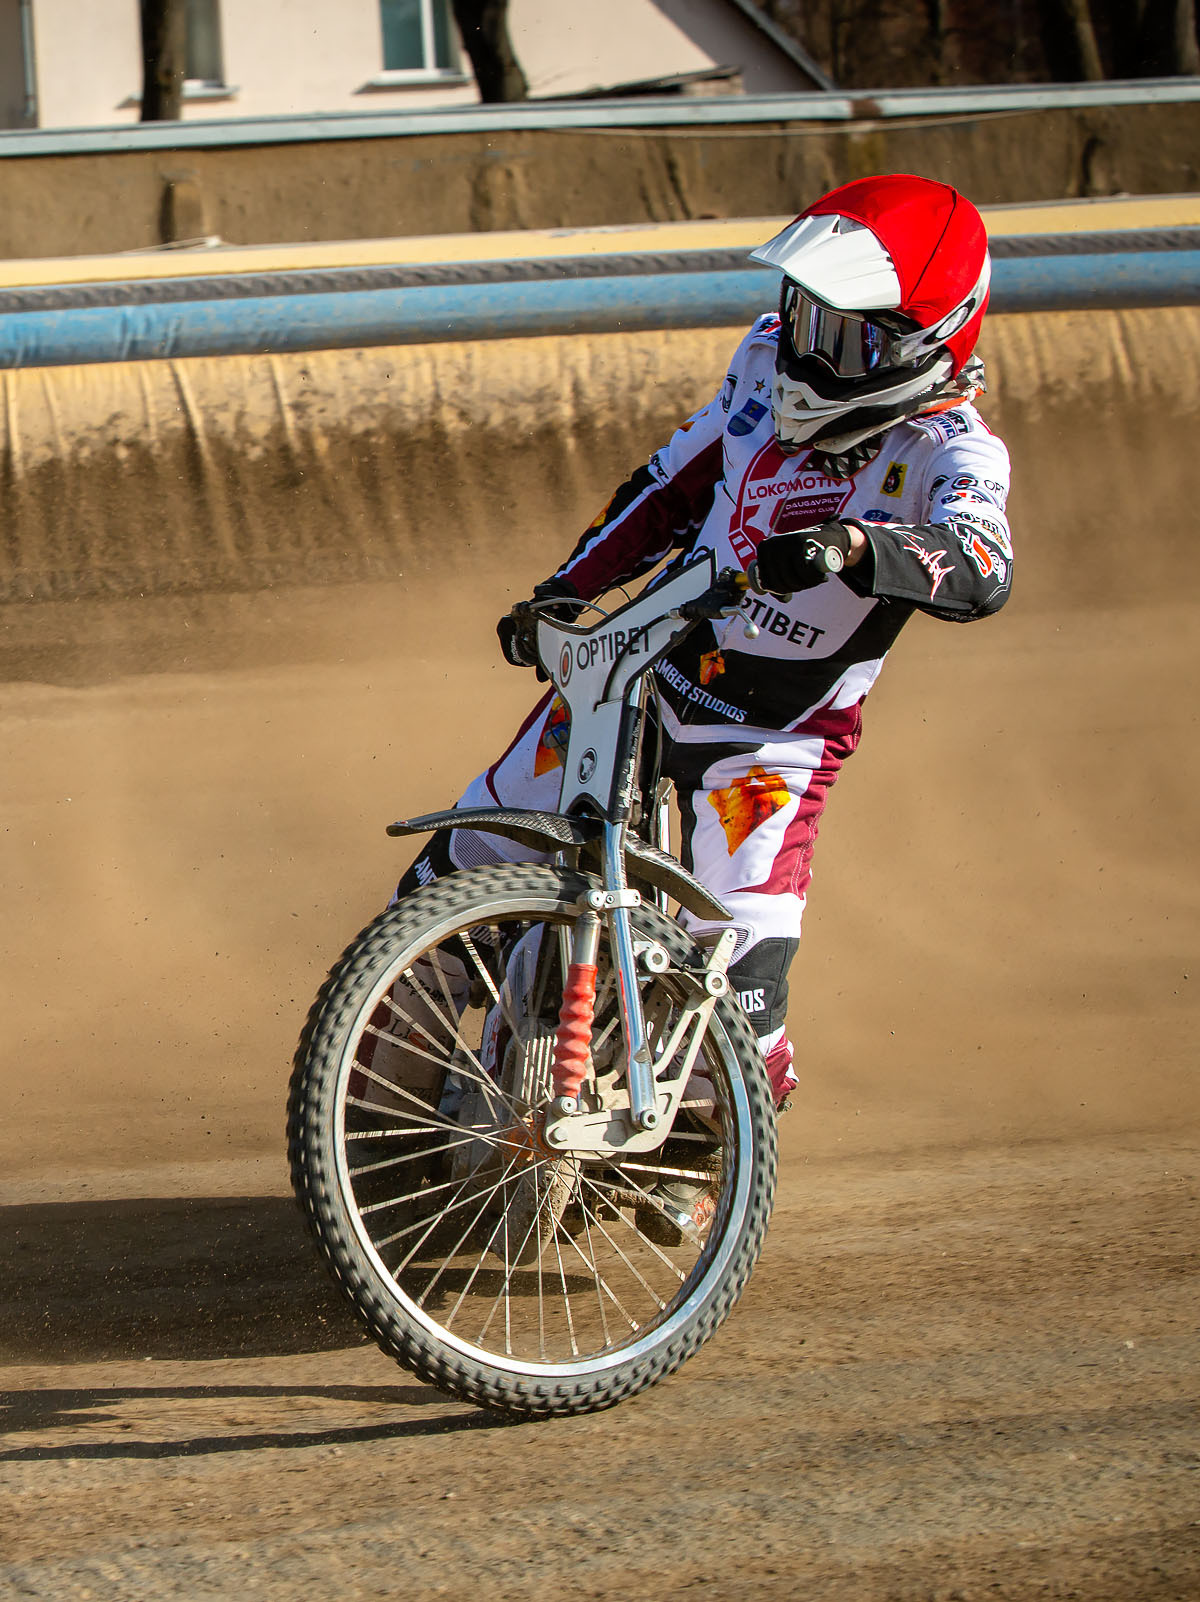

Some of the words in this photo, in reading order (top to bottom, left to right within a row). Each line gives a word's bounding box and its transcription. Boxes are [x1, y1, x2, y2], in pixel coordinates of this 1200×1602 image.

[785, 496, 840, 510] DAUGAVPILS
[576, 626, 650, 670] OPTIBET
[653, 658, 693, 696] AMBER
[687, 686, 748, 723] STUDIOS
